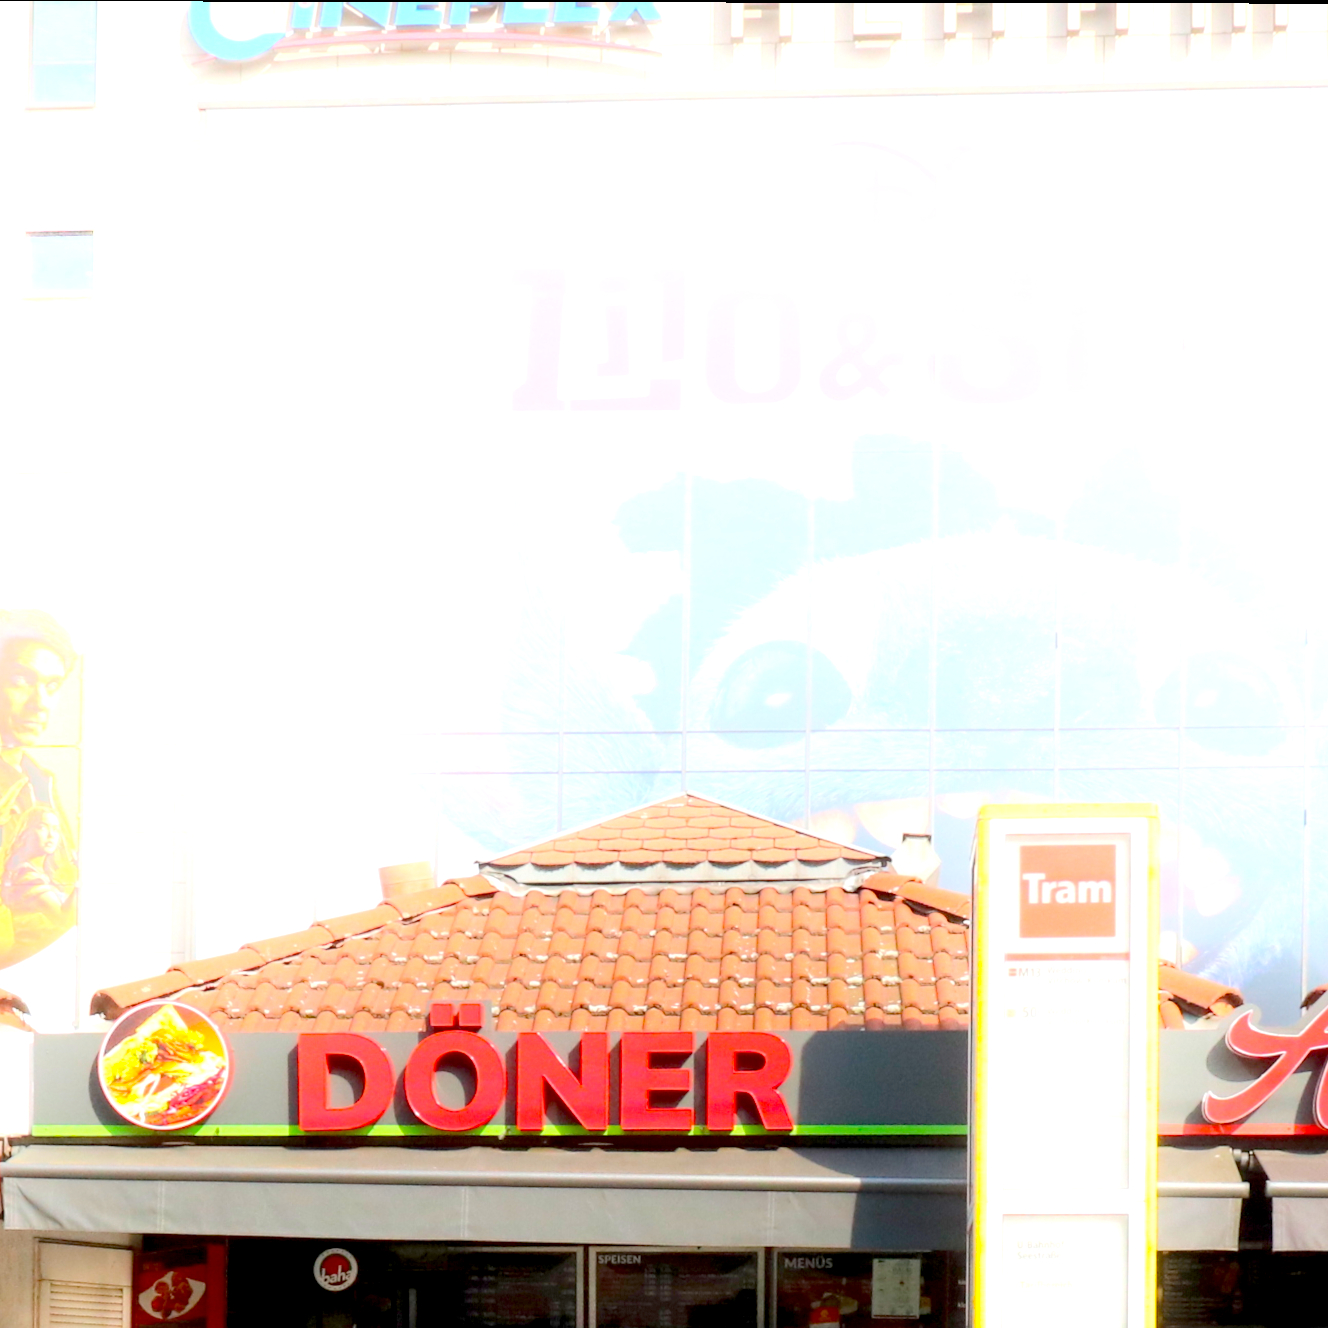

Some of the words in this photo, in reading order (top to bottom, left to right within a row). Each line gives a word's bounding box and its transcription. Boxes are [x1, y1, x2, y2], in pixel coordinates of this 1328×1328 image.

[1022, 872, 1113, 904] Tram
[296, 1001, 794, 1132] DÖNER
[597, 1254, 642, 1265] SPEISEN
[784, 1255, 834, 1269] MENÜS
